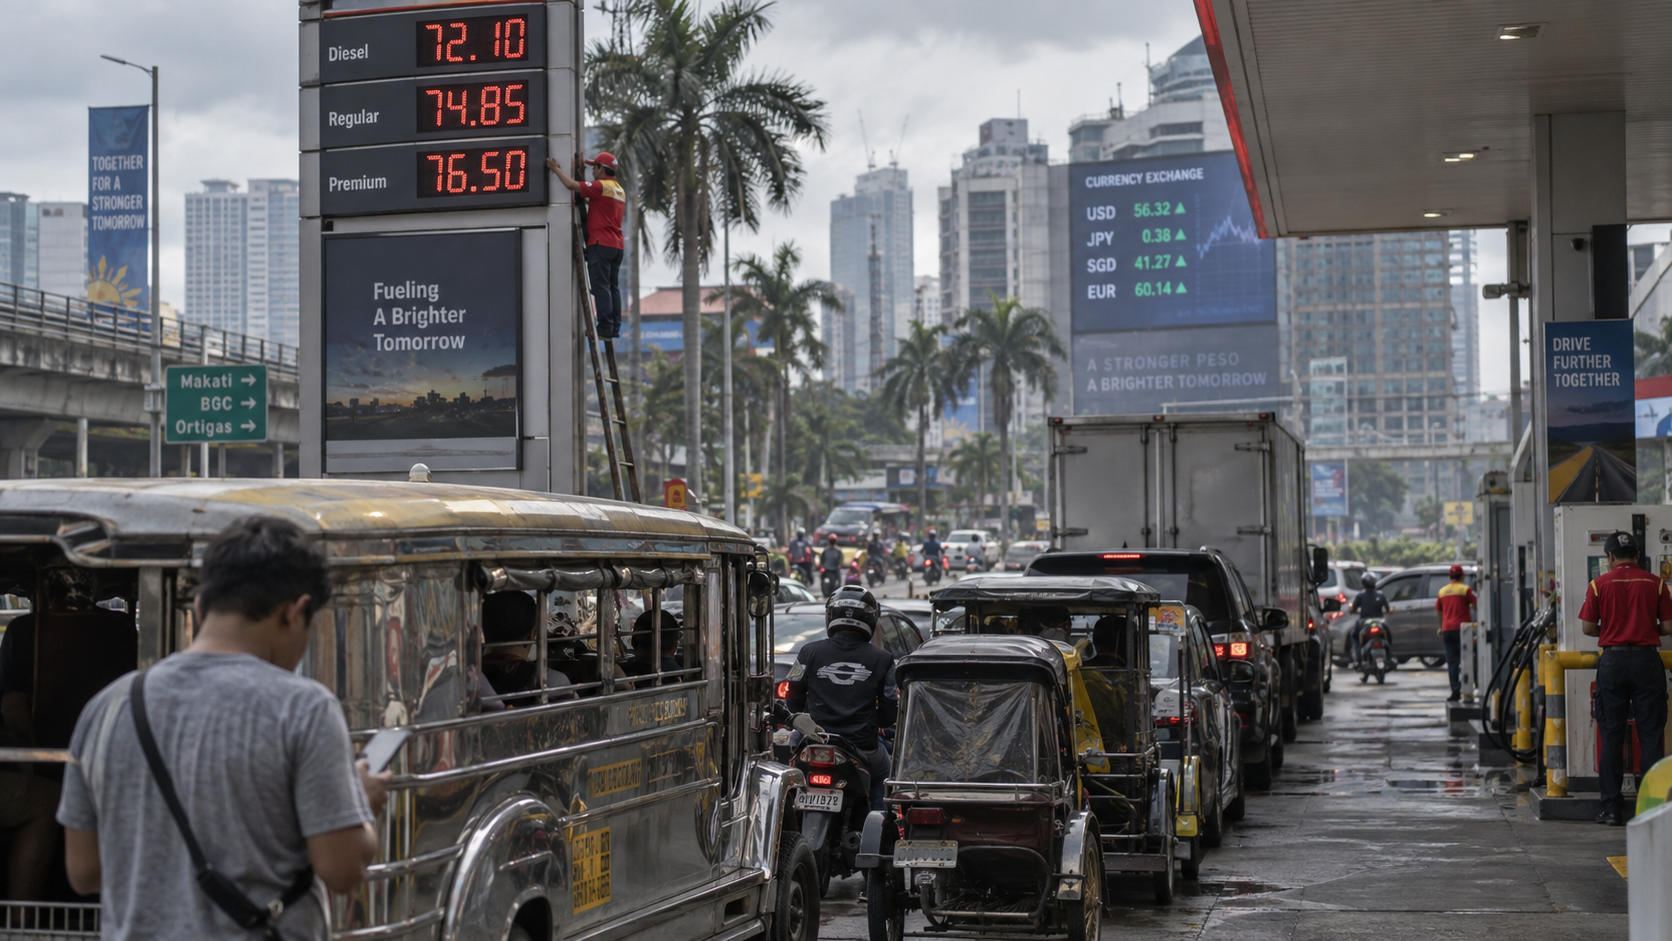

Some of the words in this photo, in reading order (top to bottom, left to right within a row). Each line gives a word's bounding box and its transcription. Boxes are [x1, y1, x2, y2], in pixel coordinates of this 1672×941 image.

[329, 44, 369, 62] Diesel
[426, 18, 525, 62] 72.10
[329, 109, 379, 129] Regular
[426, 84, 525, 127] 74.85
[92, 155, 144, 171] TOGETHER
[329, 175, 387, 192] Premium
[427, 150, 526, 193] 76.50
[92, 176, 111, 191] FOR
[114, 175, 121, 191] A
[1085, 173, 1143, 188] CURRENCY
[1146, 167, 1204, 184] EXCHANGE
[92, 194, 144, 211] STRONGER
[1087, 205, 1116, 221] USD
[1134, 201, 1171, 218] 56.32
[92, 214, 146, 231] TOMORROW
[1086, 231, 1114, 247] JPY
[1142, 228, 1171, 243] 0.38
[1087, 257, 1117, 273] SGD
[1134, 254, 1171, 270] 41.27
[373, 280, 439, 302] Fueling
[1087, 284, 1116, 299] EUR
[1135, 281, 1172, 297] 60.14
[373, 307, 387, 326] A
[392, 305, 467, 329] Brighter
[373, 333, 466, 352] Tomorrow
[1553, 337, 1591, 351] DRIVE
[1086, 357, 1098, 373] A
[1104, 354, 1190, 372] STRONGER
[1197, 352, 1240, 367] PESO
[1553, 354, 1612, 370] FURTHER
[181, 373, 232, 389] Makati
[1086, 378, 1098, 392] A
[1101, 375, 1174, 392] BRIGHTER
[1178, 371, 1268, 389] TOMORROW
[1554, 372, 1621, 388] TOGETHER
[201, 396, 232, 411] BGC
[175, 419, 232, 438] Ortigas
